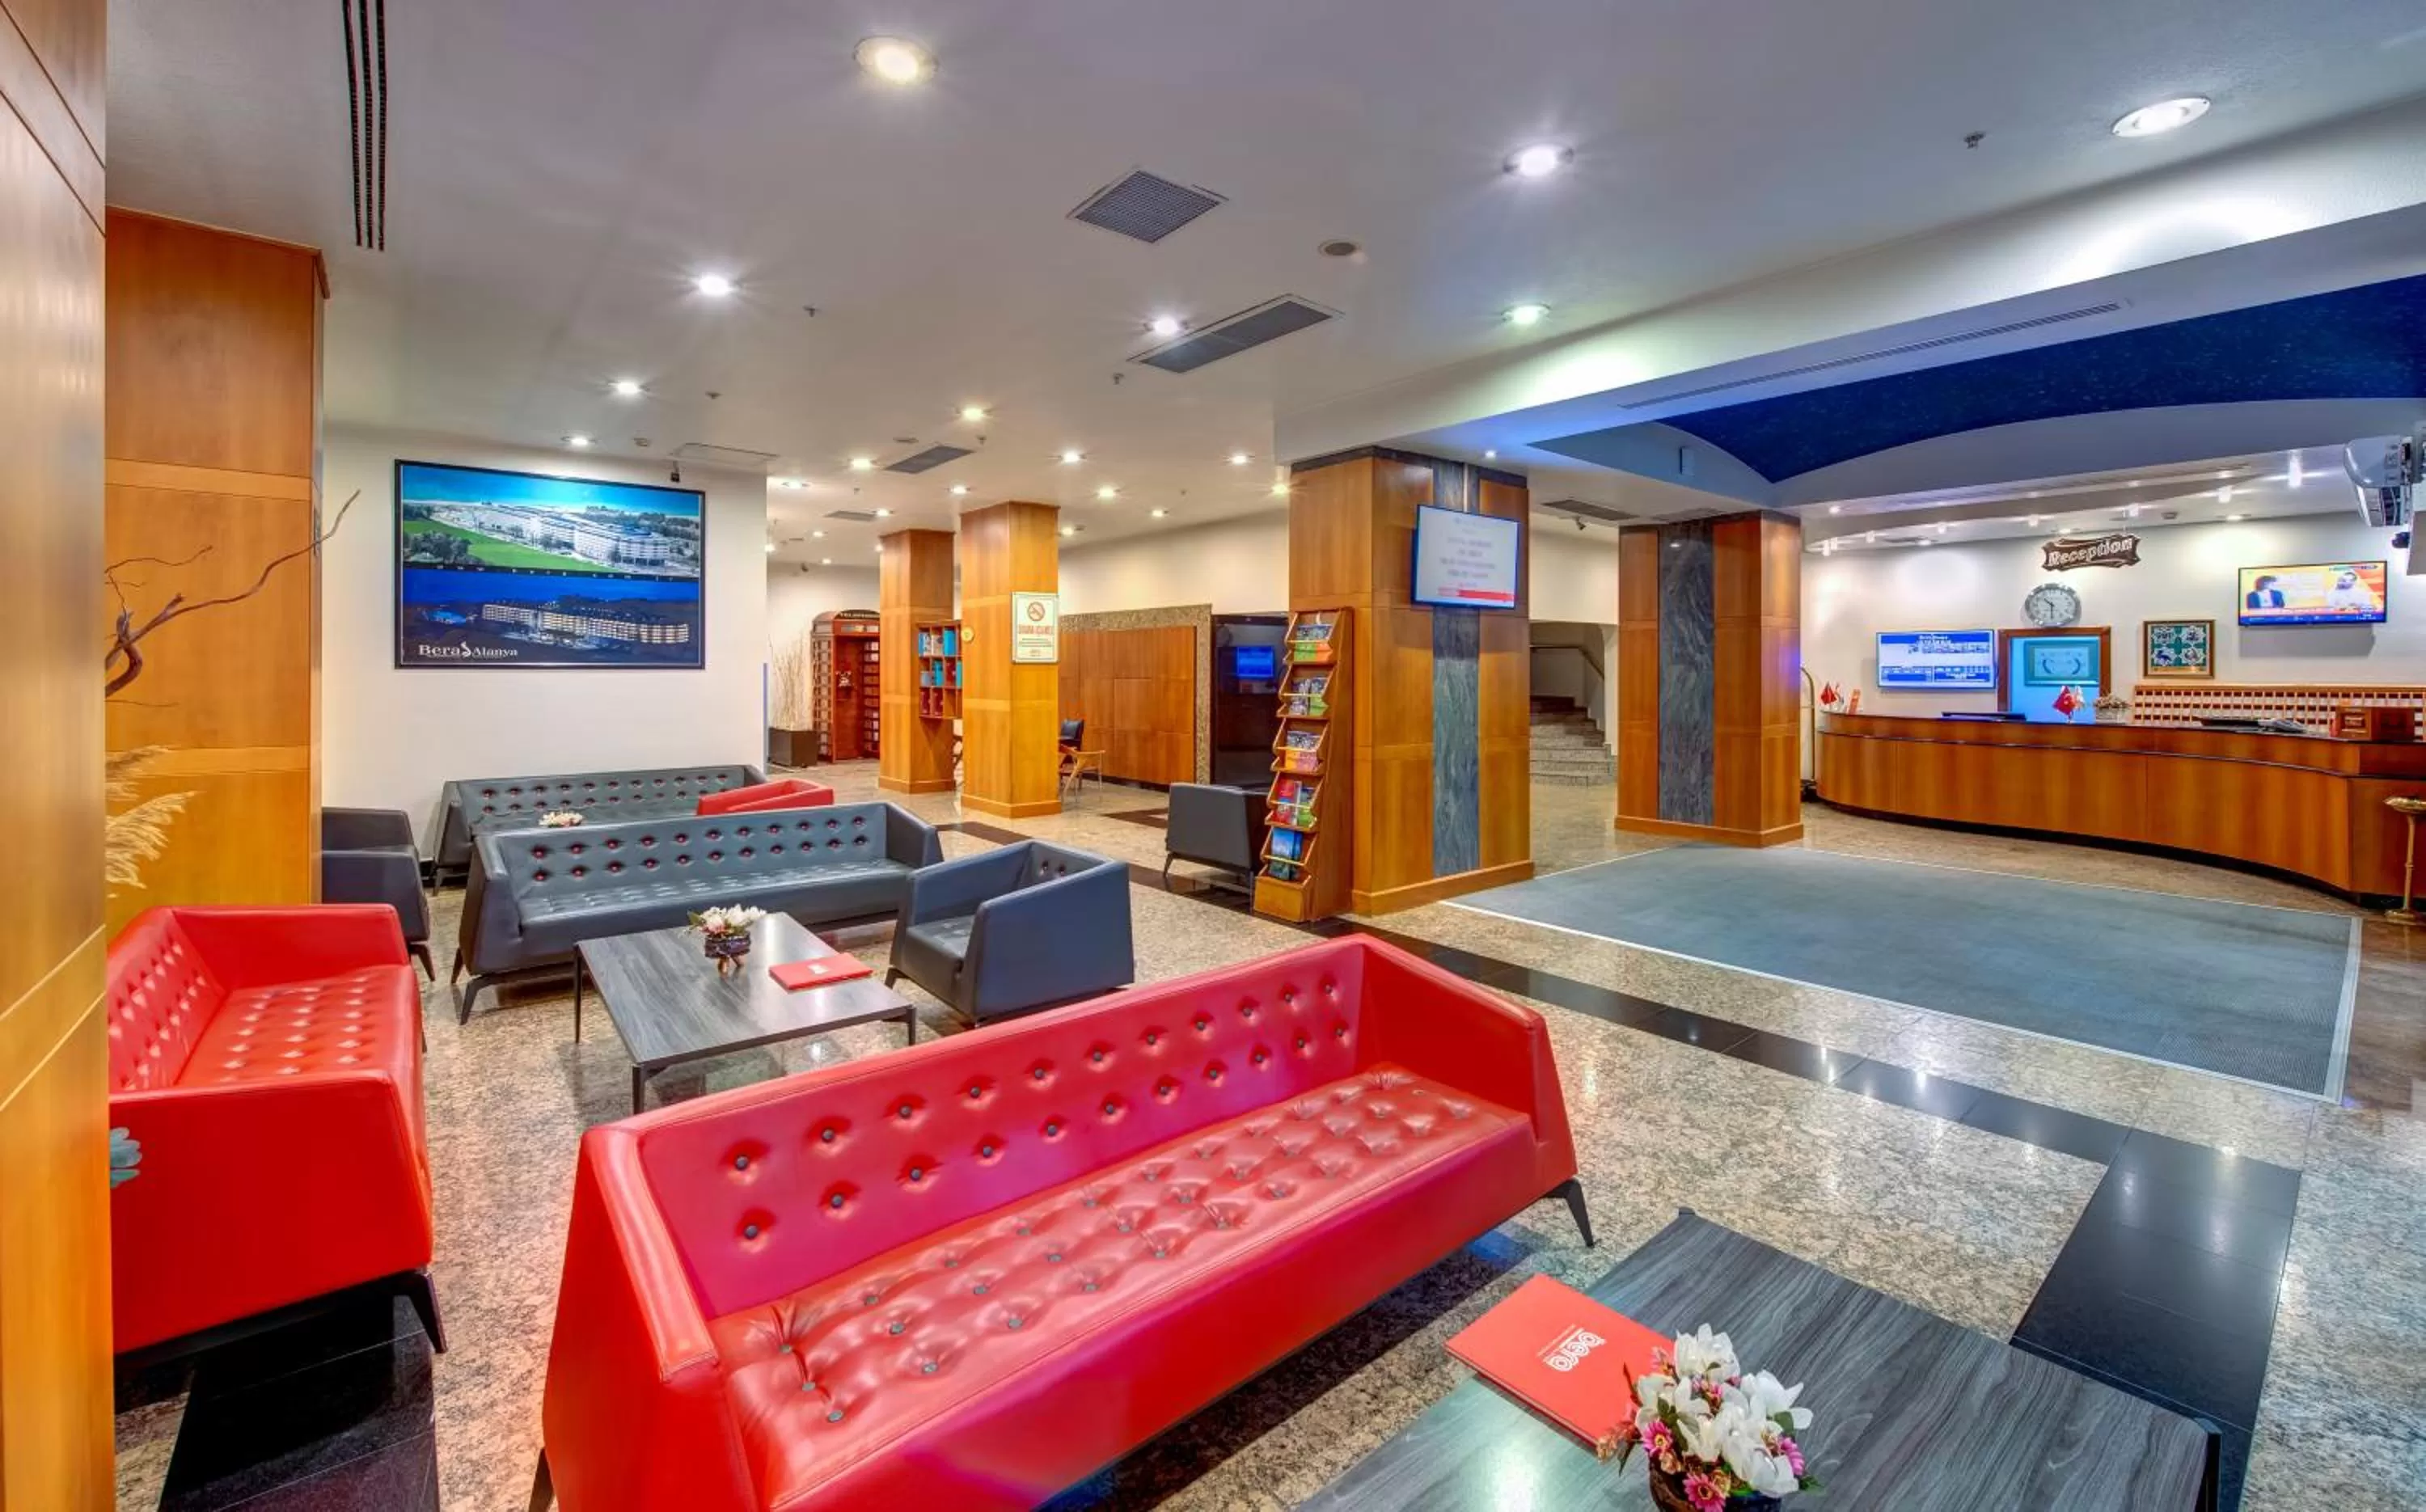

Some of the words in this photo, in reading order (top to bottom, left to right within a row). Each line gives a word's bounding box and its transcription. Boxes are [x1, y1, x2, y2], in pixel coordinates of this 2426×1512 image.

[2048, 538, 2133, 566] Reception
[418, 644, 460, 657] Bera
[471, 646, 519, 657] Alanya
